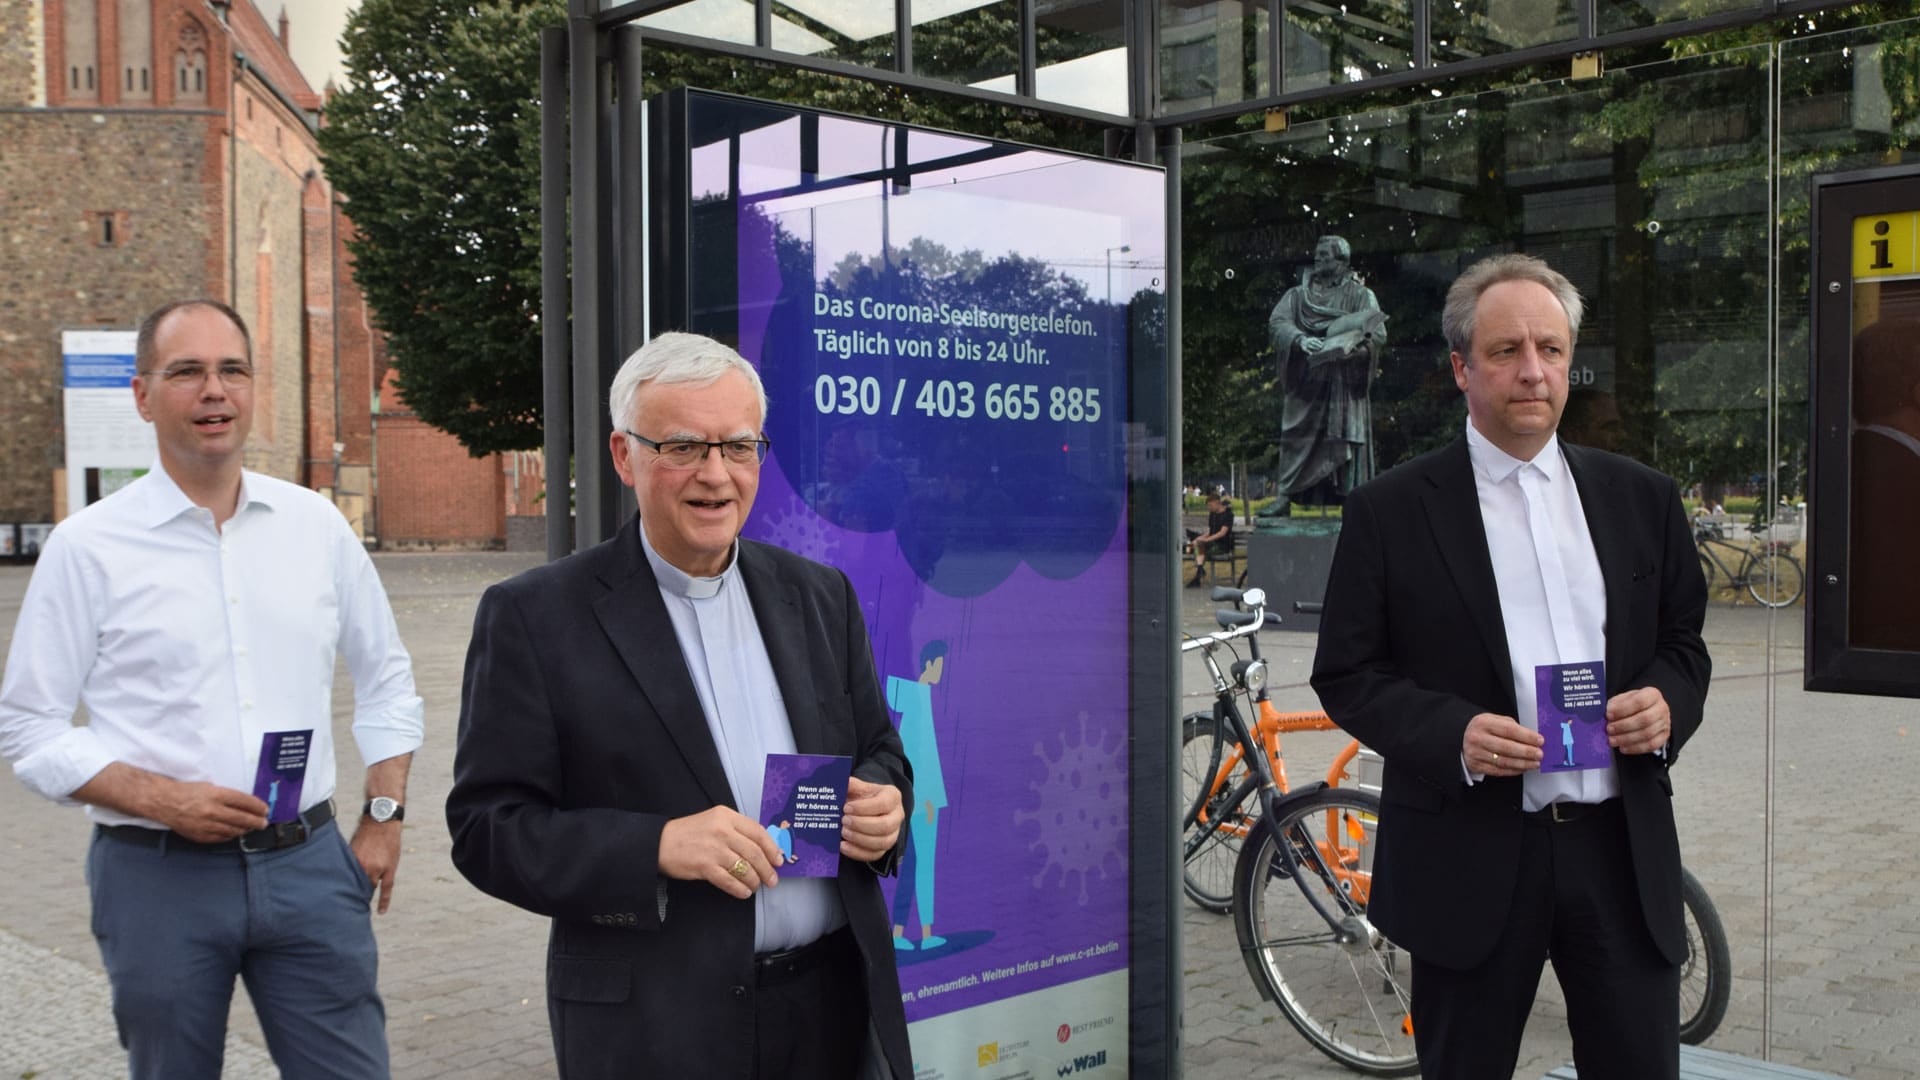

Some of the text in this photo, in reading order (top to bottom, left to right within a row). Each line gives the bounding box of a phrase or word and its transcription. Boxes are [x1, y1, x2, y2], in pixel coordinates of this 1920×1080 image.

[814, 292, 1098, 337] Das Corona-Seelsorgetelefon.
[813, 328, 1050, 365] Täglich von 8 bis 24 Uhr.
[815, 374, 1101, 423] 030 / 403 665 885
[798, 785, 834, 794] Wenn alles
[806, 792, 819, 800] viel
[819, 793, 837, 801] wird:
[796, 802, 809, 810] Wir
[809, 802, 829, 810] hören
[917, 974, 980, 999] ehrenamtlich.
[981, 967, 1015, 983] Weitere
[1016, 960, 1039, 975] Infos
[1040, 954, 1055, 969] auf
[1055, 940, 1119, 964] www.c-st.berlin
[1073, 1049, 1107, 1073] Wall
